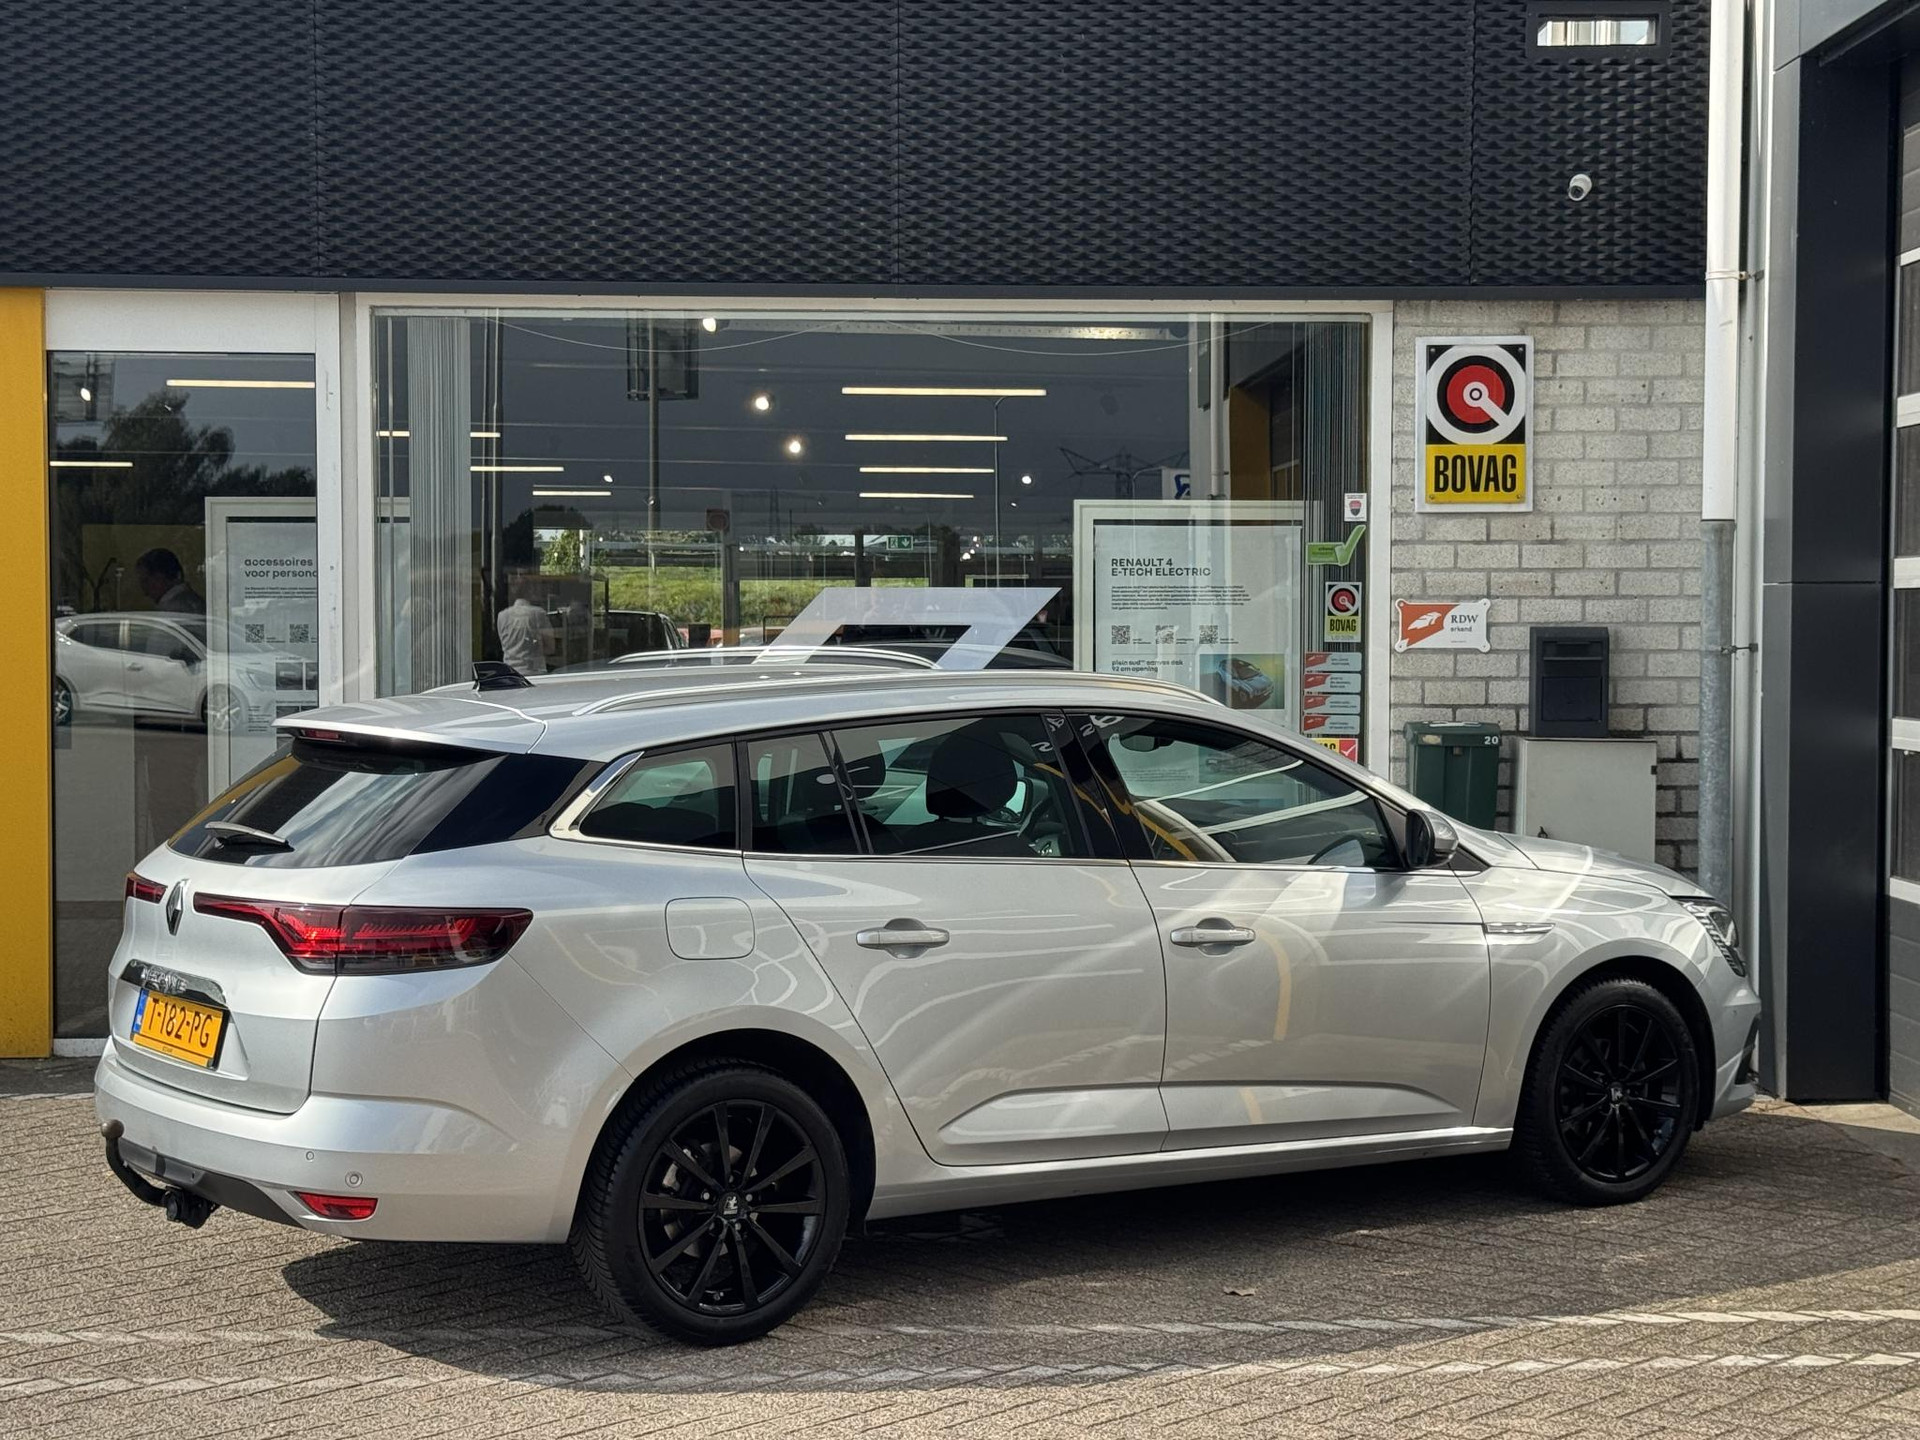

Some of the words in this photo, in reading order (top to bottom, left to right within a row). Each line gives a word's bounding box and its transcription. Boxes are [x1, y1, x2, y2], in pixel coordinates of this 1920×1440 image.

[1434, 454, 1517, 493] BOVAG
[244, 557, 314, 567] accessoires
[1111, 558, 1164, 567] RENAULT
[1165, 558, 1173, 567] 4
[244, 570, 271, 578] voor
[1111, 567, 1153, 577] E-TECH
[1155, 567, 1212, 577] ELECTRIC
[1450, 614, 1479, 624] RDW
[1329, 618, 1357, 632] BOVAG
[1484, 736, 1499, 745] 20
[149, 998, 213, 1048] T-182-PG
